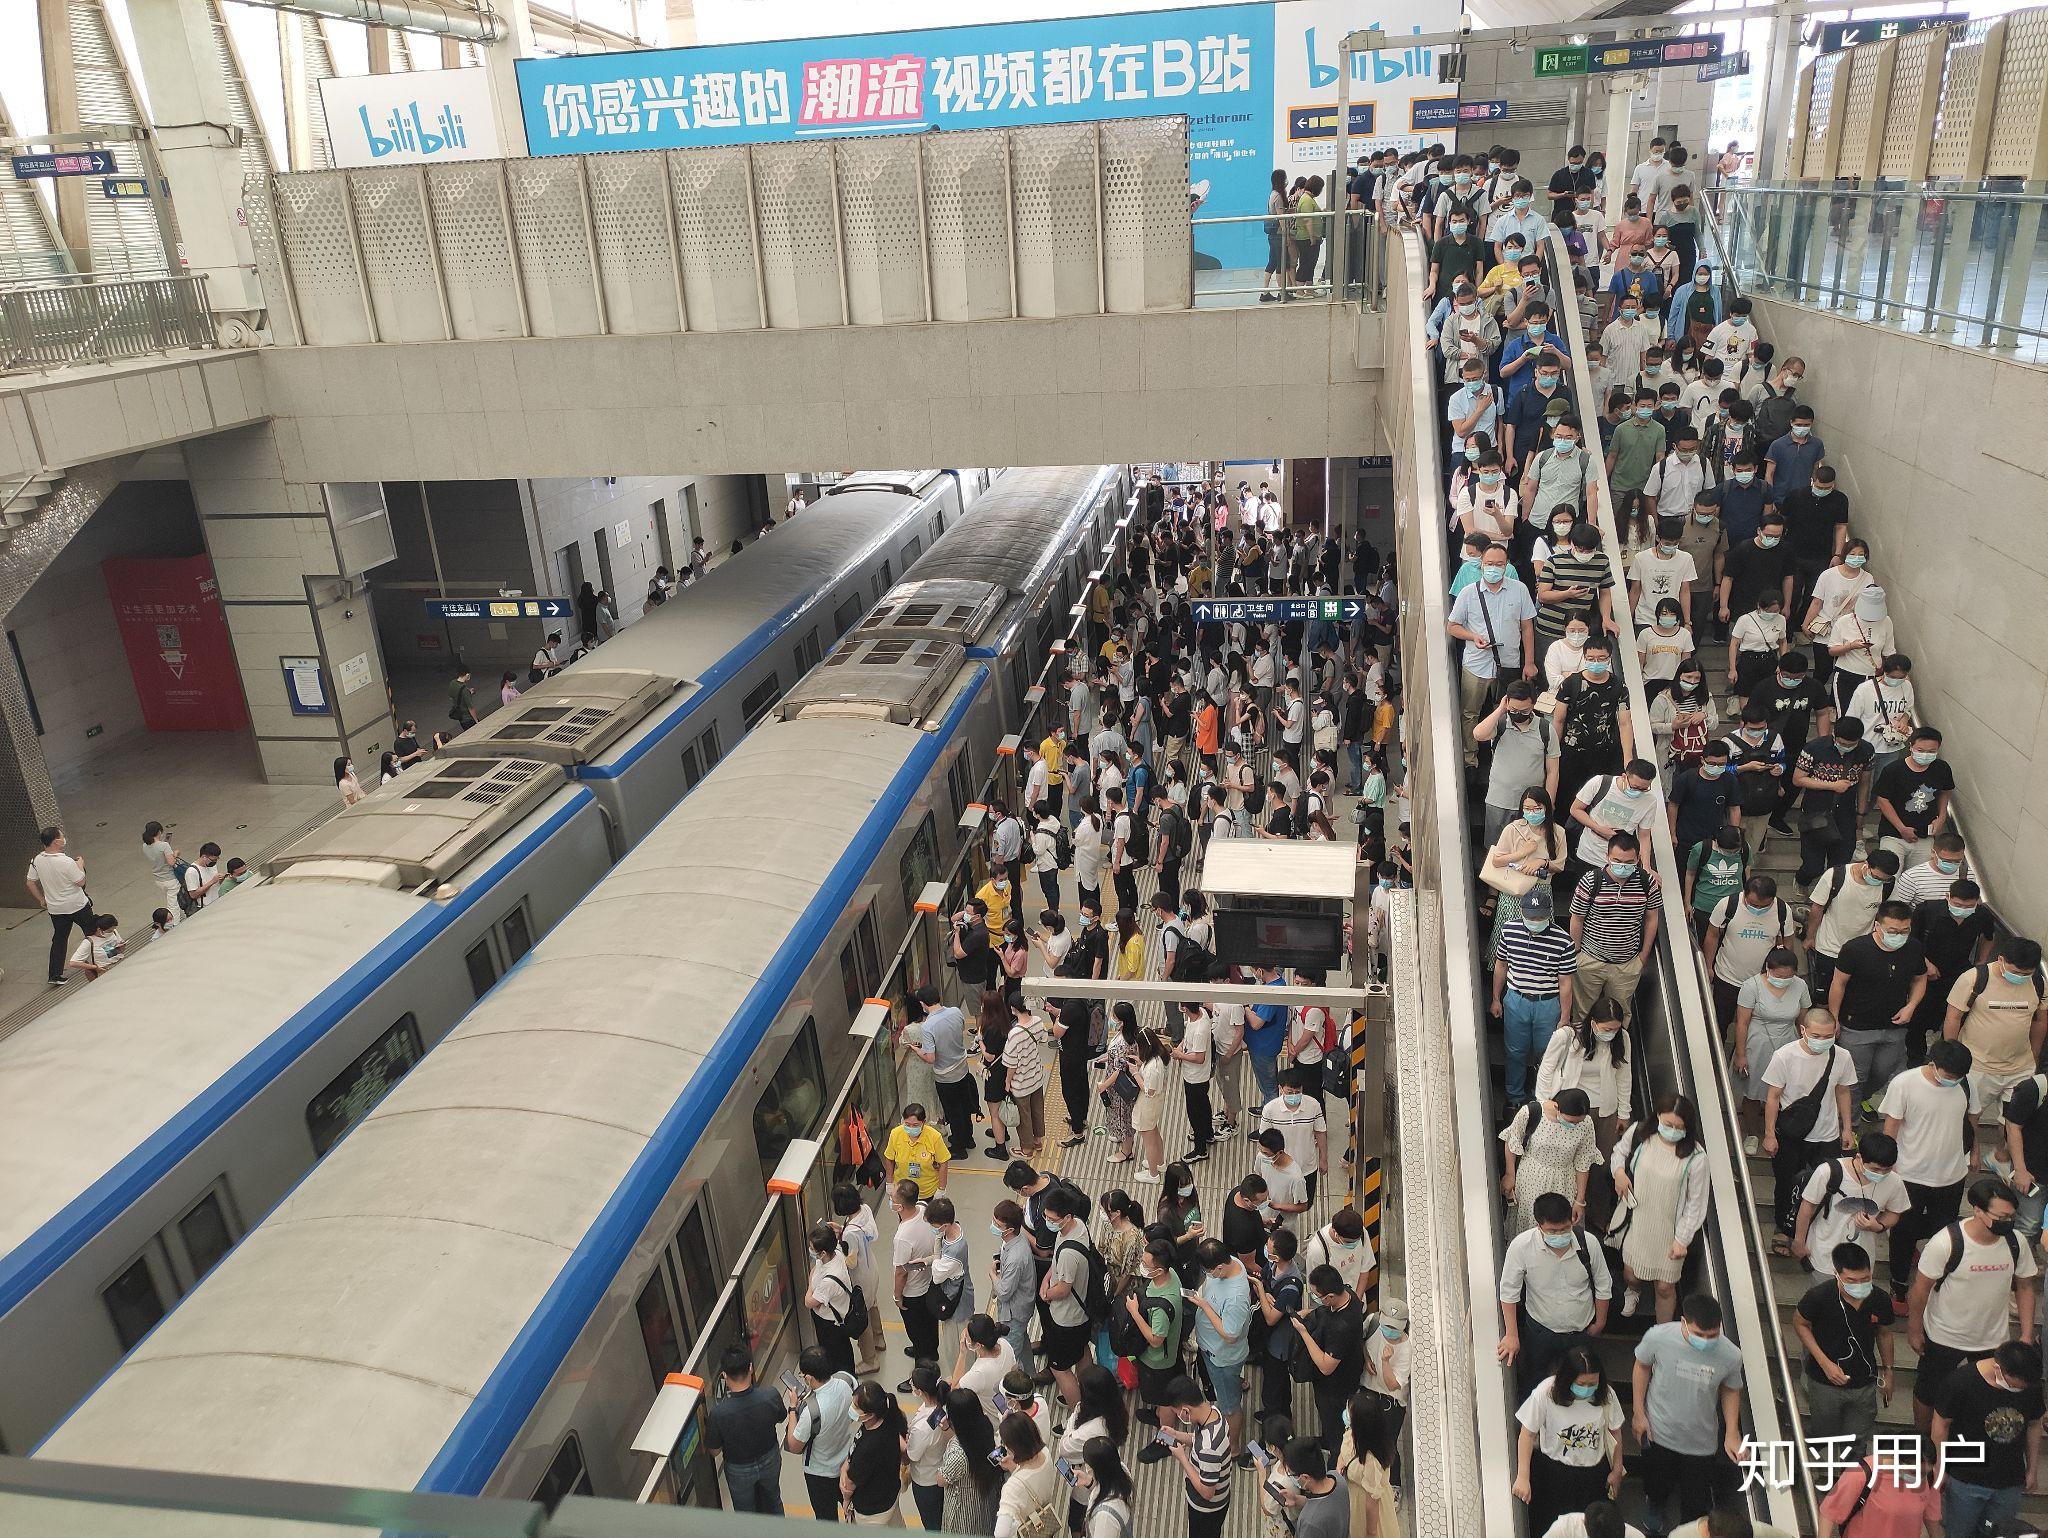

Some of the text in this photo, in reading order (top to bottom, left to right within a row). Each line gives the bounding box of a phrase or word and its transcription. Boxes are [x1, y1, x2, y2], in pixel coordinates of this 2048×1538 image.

[1881, 22, 1898, 38] 出
[1920, 21, 1928, 29] A
[359, 101, 466, 157] bilibili
[441, 603, 481, 612] 开往东直门
[1247, 603, 1274, 612] 卫生间
[1708, 878, 1739, 886] adidas
